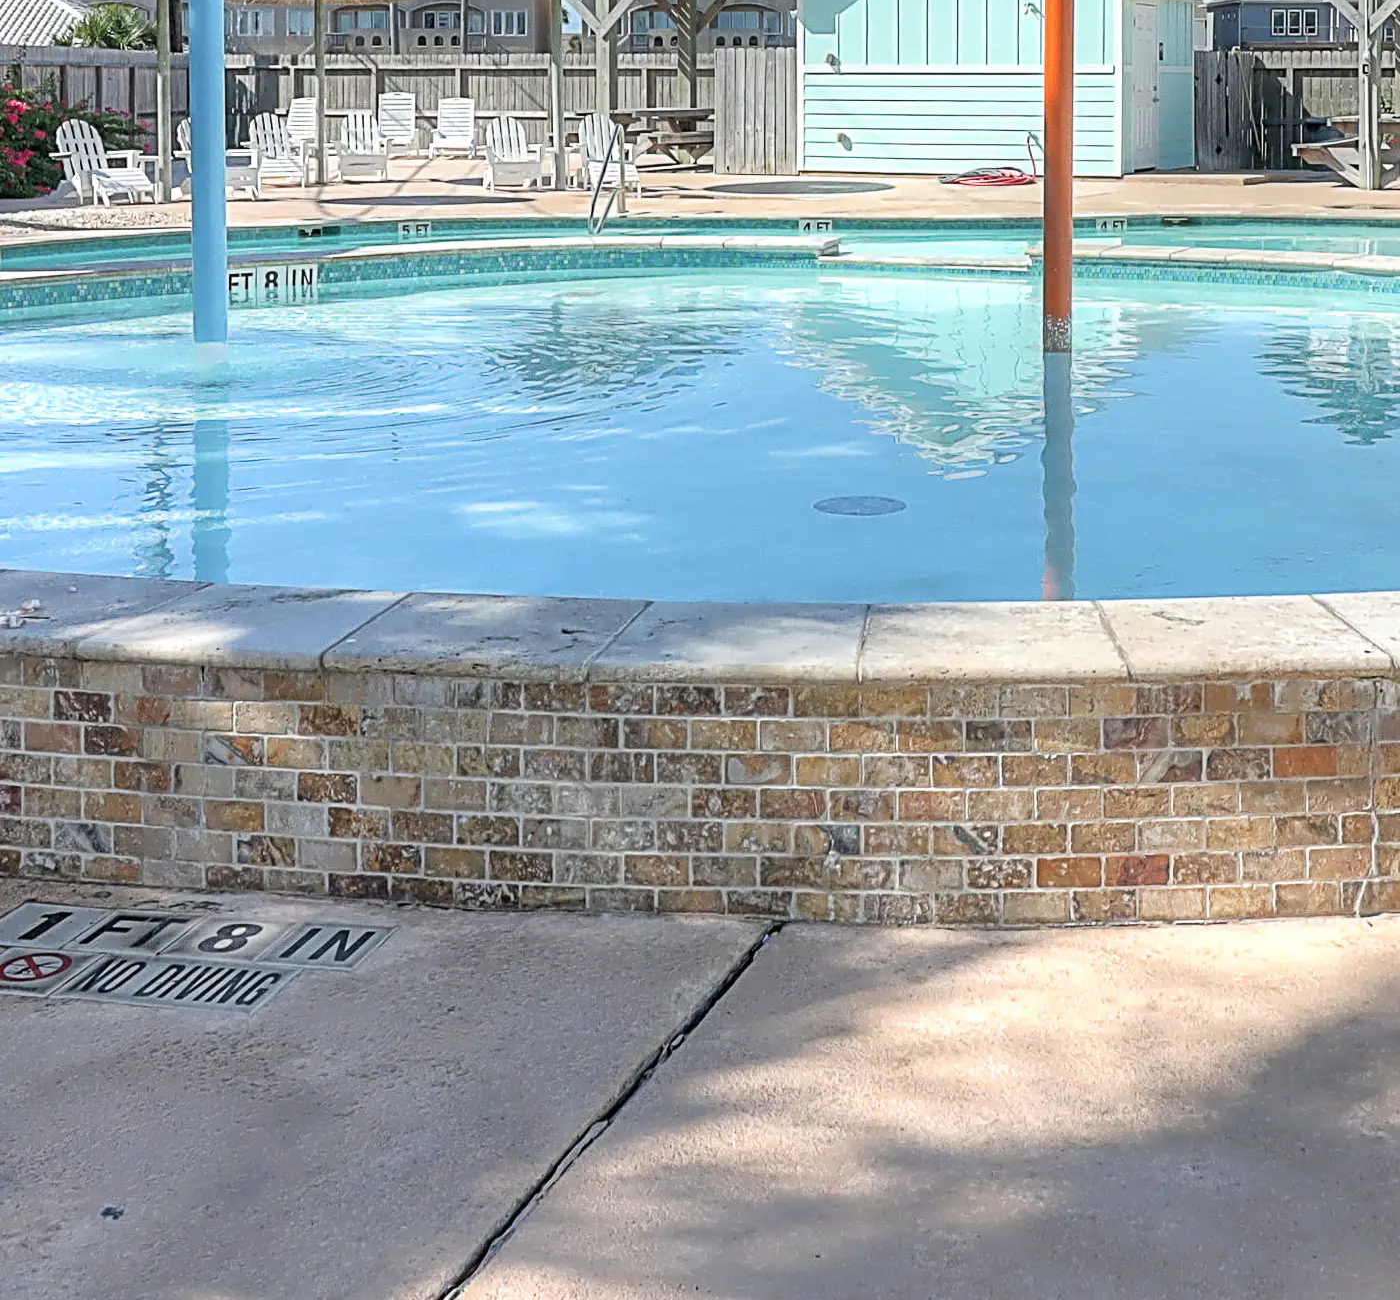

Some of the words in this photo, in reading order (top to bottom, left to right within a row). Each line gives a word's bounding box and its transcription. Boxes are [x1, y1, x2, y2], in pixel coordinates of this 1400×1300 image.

[402, 224, 410, 234] 5
[415, 223, 430, 234] FT
[816, 221, 830, 231] FT
[1112, 220, 1125, 229] FT
[228, 272, 253, 291] FT
[264, 270, 279, 288] 8
[292, 268, 314, 286] IN
[18, 911, 74, 941] 1
[79, 915, 190, 948] FT
[198, 923, 264, 954] 8
[279, 927, 376, 962] IN
[78, 957, 148, 994] NO
[134, 962, 284, 1007] DIVING
